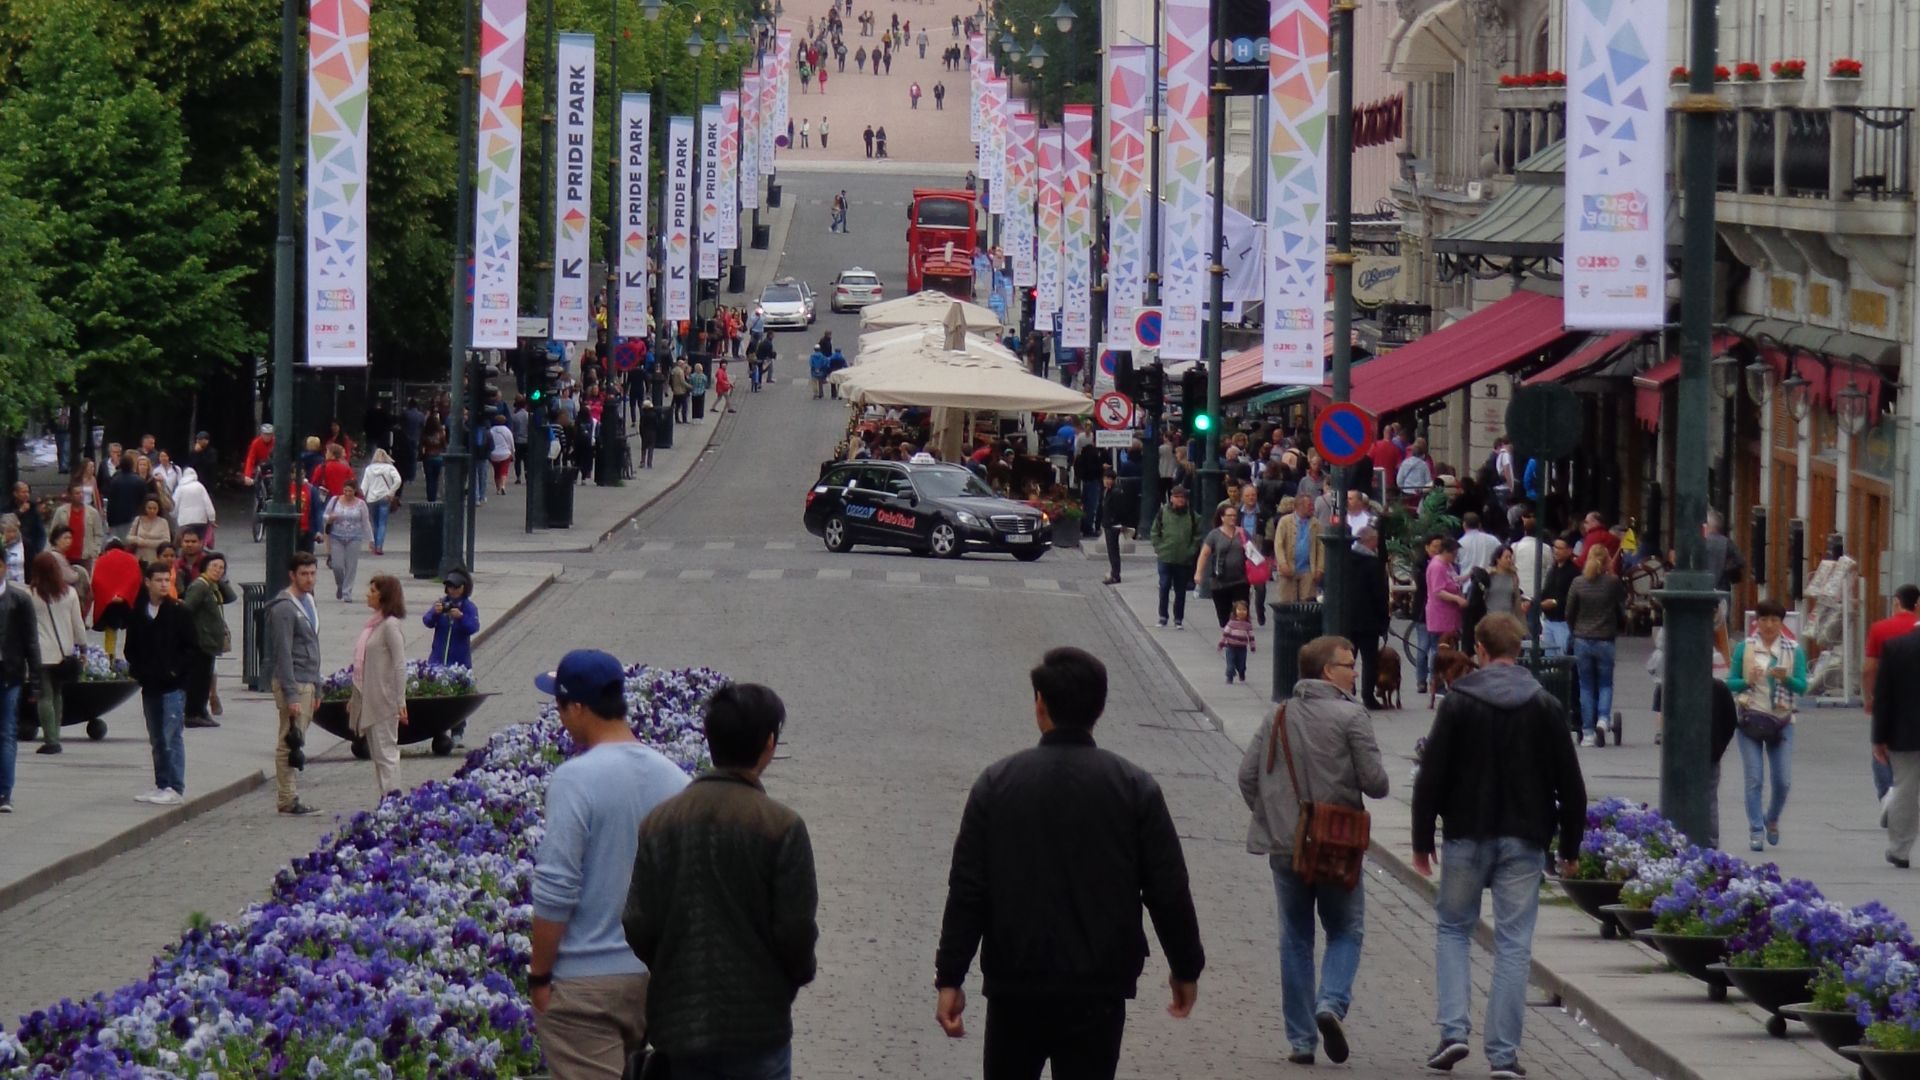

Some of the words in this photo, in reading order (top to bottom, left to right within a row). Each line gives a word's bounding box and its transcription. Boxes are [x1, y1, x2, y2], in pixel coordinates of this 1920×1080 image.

[569, 65, 586, 126] PARK
[630, 118, 643, 166] PARK
[676, 138, 688, 178] PARK
[707, 123, 718, 158] PARK
[567, 134, 584, 201] PRIDE
[705, 161, 716, 200] PRIDE
[629, 172, 642, 226] PRIDE
[674, 183, 686, 228] PRIDE
